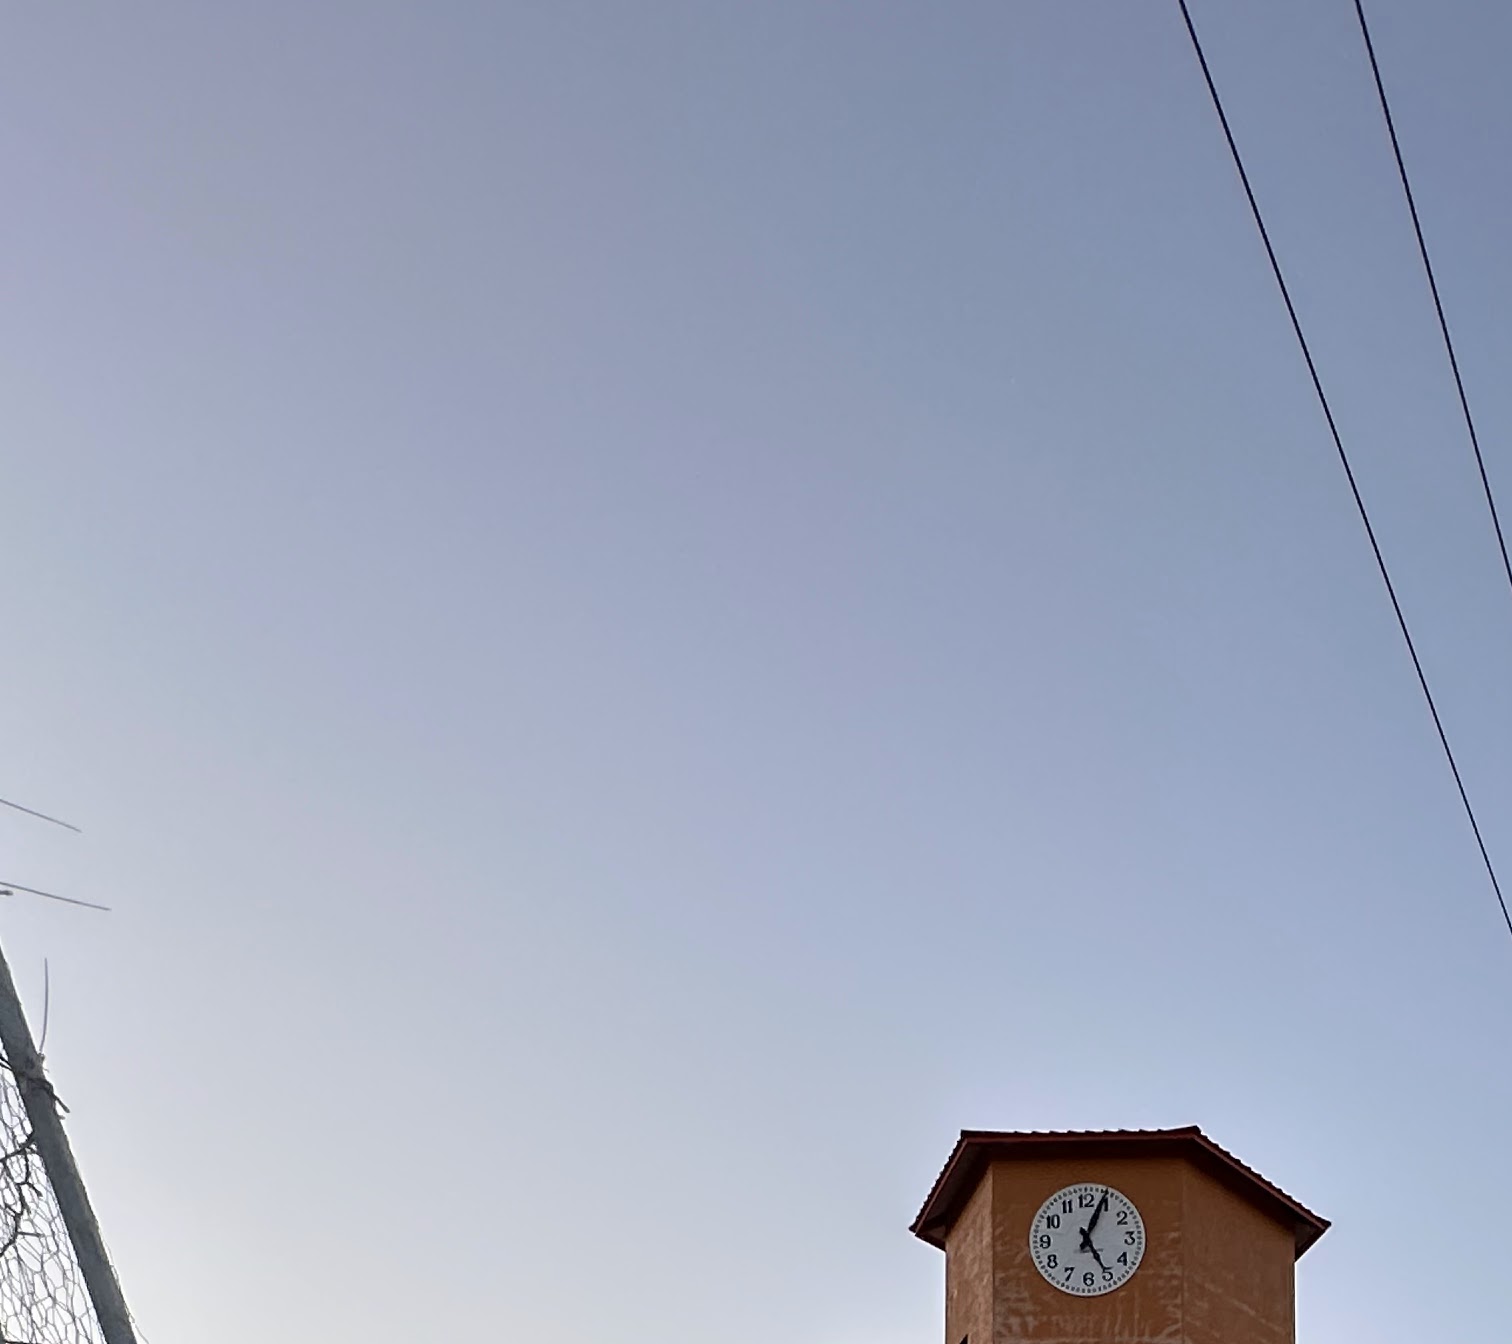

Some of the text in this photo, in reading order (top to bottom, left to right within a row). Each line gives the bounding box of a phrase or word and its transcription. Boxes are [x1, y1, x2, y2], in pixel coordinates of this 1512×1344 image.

[1062, 1199, 1073, 1214] 11
[1078, 1193, 1094, 1208] 12
[1046, 1214, 1060, 1229] 10
[1116, 1211, 1128, 1226] 2
[1039, 1234, 1051, 1249] 9
[1124, 1231, 1136, 1246] 3
[1047, 1254, 1058, 1269] 8
[1116, 1251, 1128, 1266] 4
[1064, 1266, 1075, 1281] 7
[1082, 1272, 1095, 1287] 6
[1102, 1266, 1114, 1281] 5
